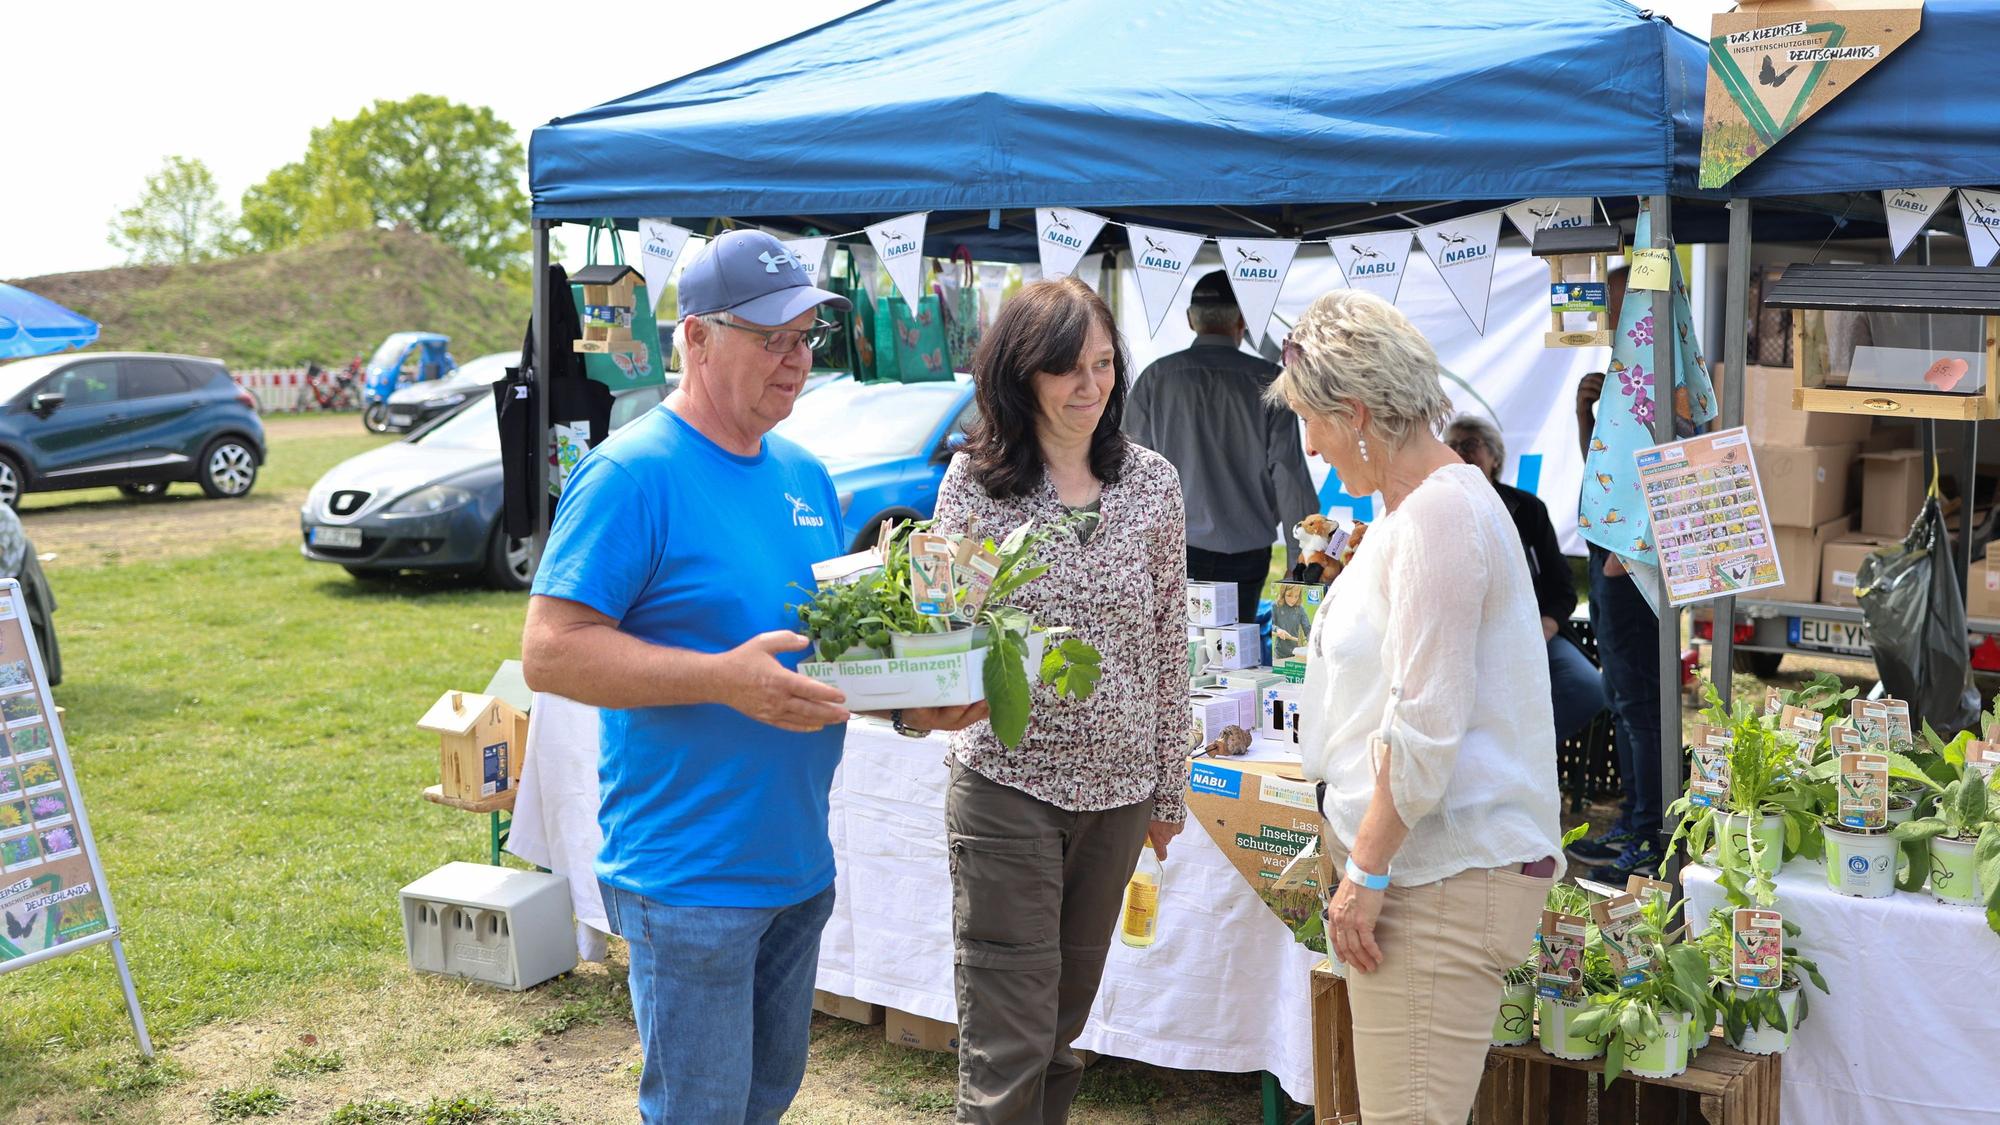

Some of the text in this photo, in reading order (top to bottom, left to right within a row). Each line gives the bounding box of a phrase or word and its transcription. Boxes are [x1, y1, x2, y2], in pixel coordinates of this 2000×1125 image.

[1730, 22, 1803, 44] DAS KLEINSTE
[1733, 38, 1824, 54] INSEKTENSCHUTZGEBIET
[1789, 46, 1875, 61] DEUTSCHLANDS
[1894, 198, 1928, 212] NABU
[1552, 215, 1582, 229] ABU
[1974, 215, 2000, 226] NAB
[1048, 231, 1082, 248] NABU
[647, 244, 674, 258] NABU
[888, 241, 915, 257] NABU
[1446, 244, 1486, 263] NABU
[1145, 256, 1181, 271] NABU
[1356, 262, 1396, 275] NABU
[1634, 264, 1655, 276] 10,-
[1240, 268, 1277, 279] NABU
[798, 515, 824, 527] NABU
[1802, 621, 1828, 642] EU
[804, 655, 962, 677] Wir lieben Pflanzen!
[1193, 773, 1227, 788] NABU
[1292, 818, 1319, 832] Lass
[1236, 837, 1301, 857] schutzgebi
[0, 879, 29, 899] EINSTE
[25, 884, 89, 912] DEUTSCHLANDS
